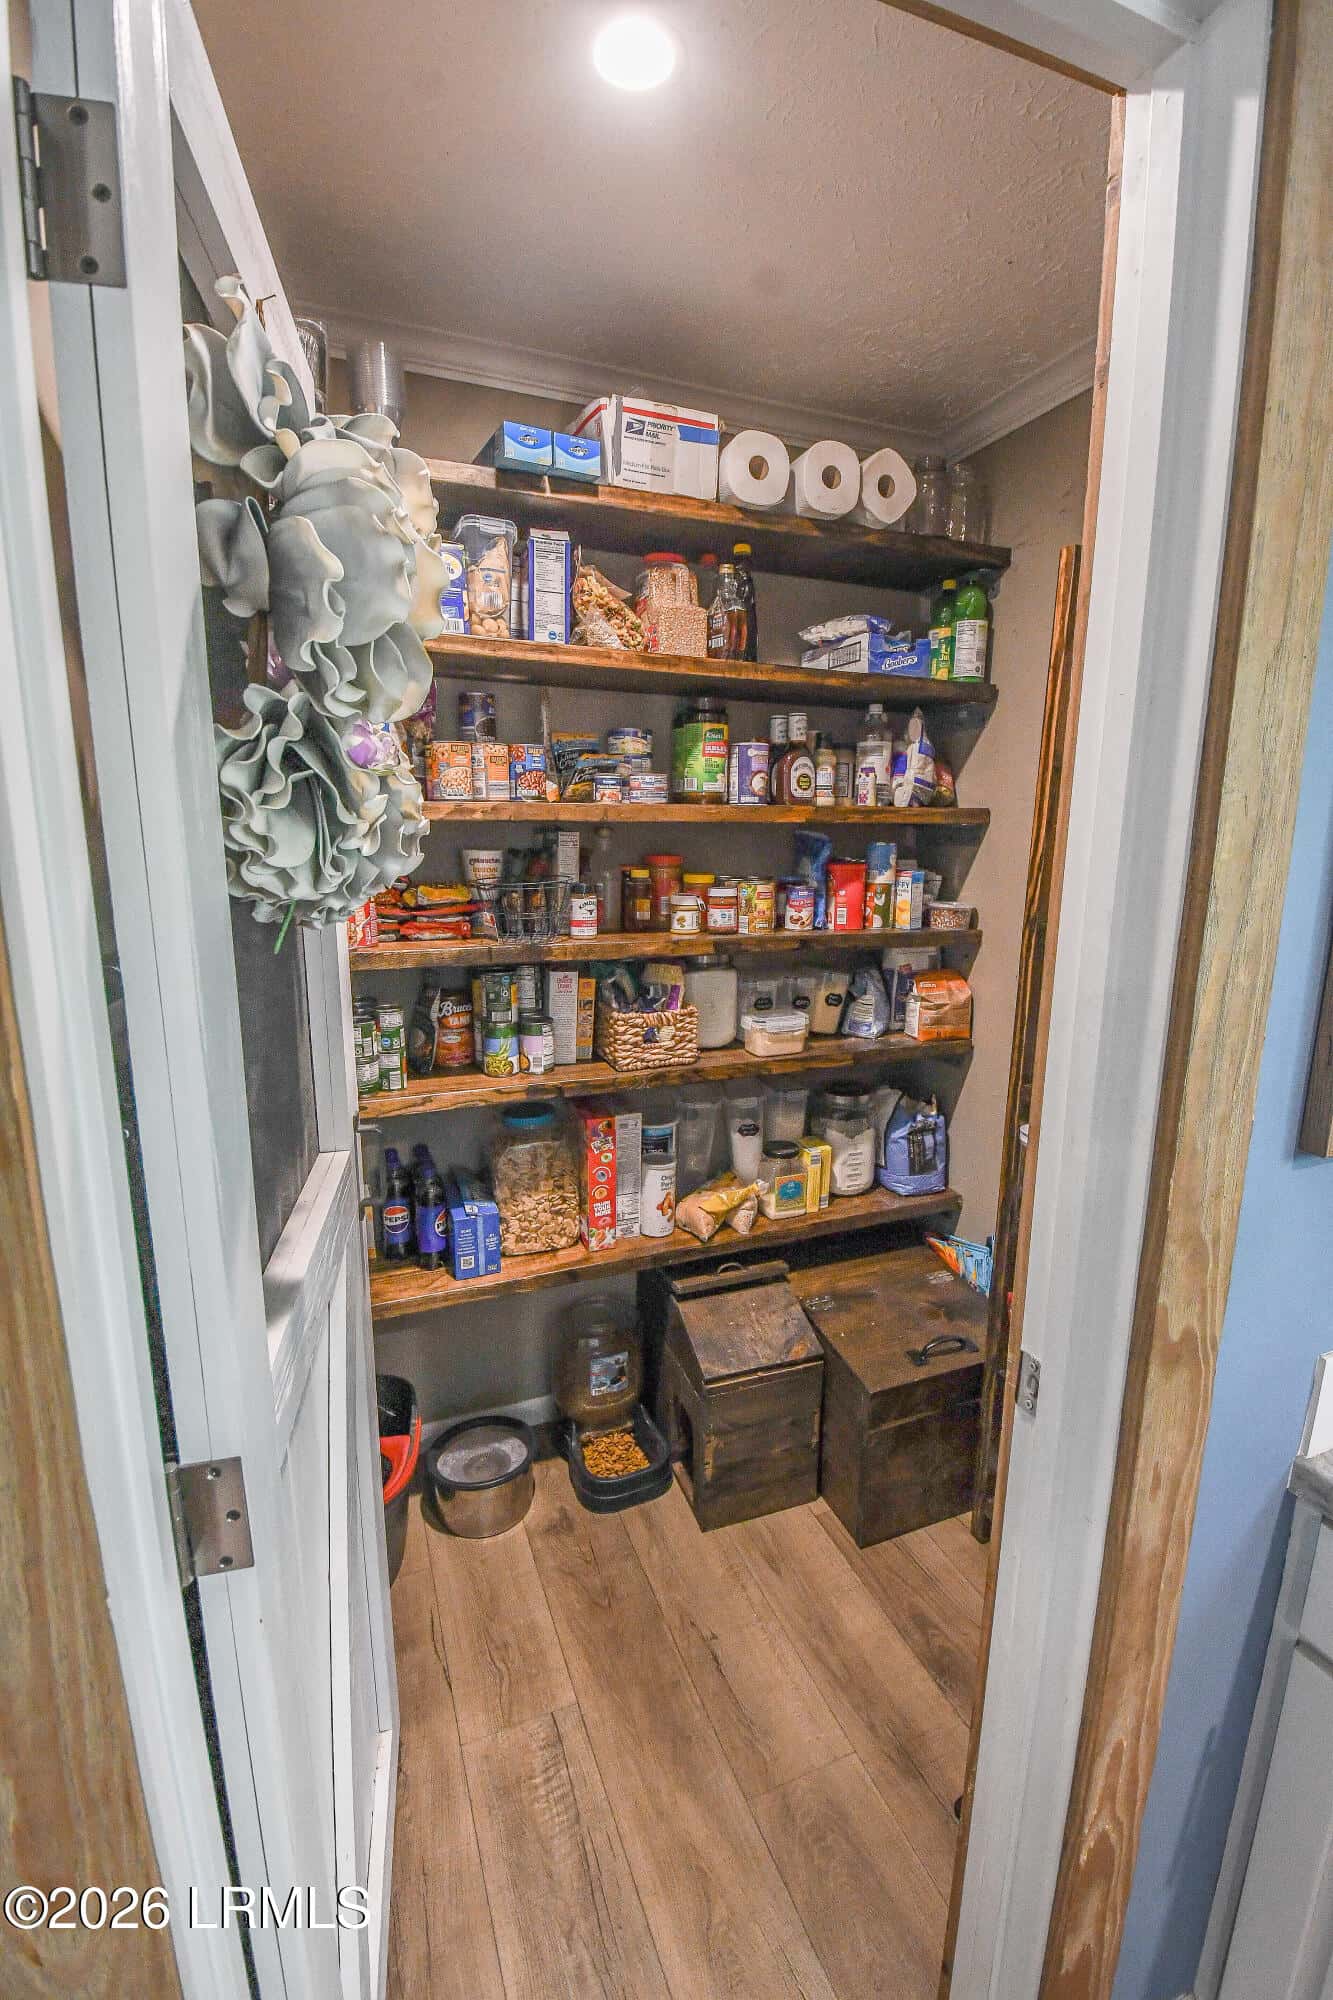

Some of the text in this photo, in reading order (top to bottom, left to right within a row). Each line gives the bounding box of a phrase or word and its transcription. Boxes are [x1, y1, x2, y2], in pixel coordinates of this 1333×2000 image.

[647, 421, 674, 432] PRIORITY
[884, 656, 916, 669] Goobers
[384, 1213, 409, 1224] PEPSI
